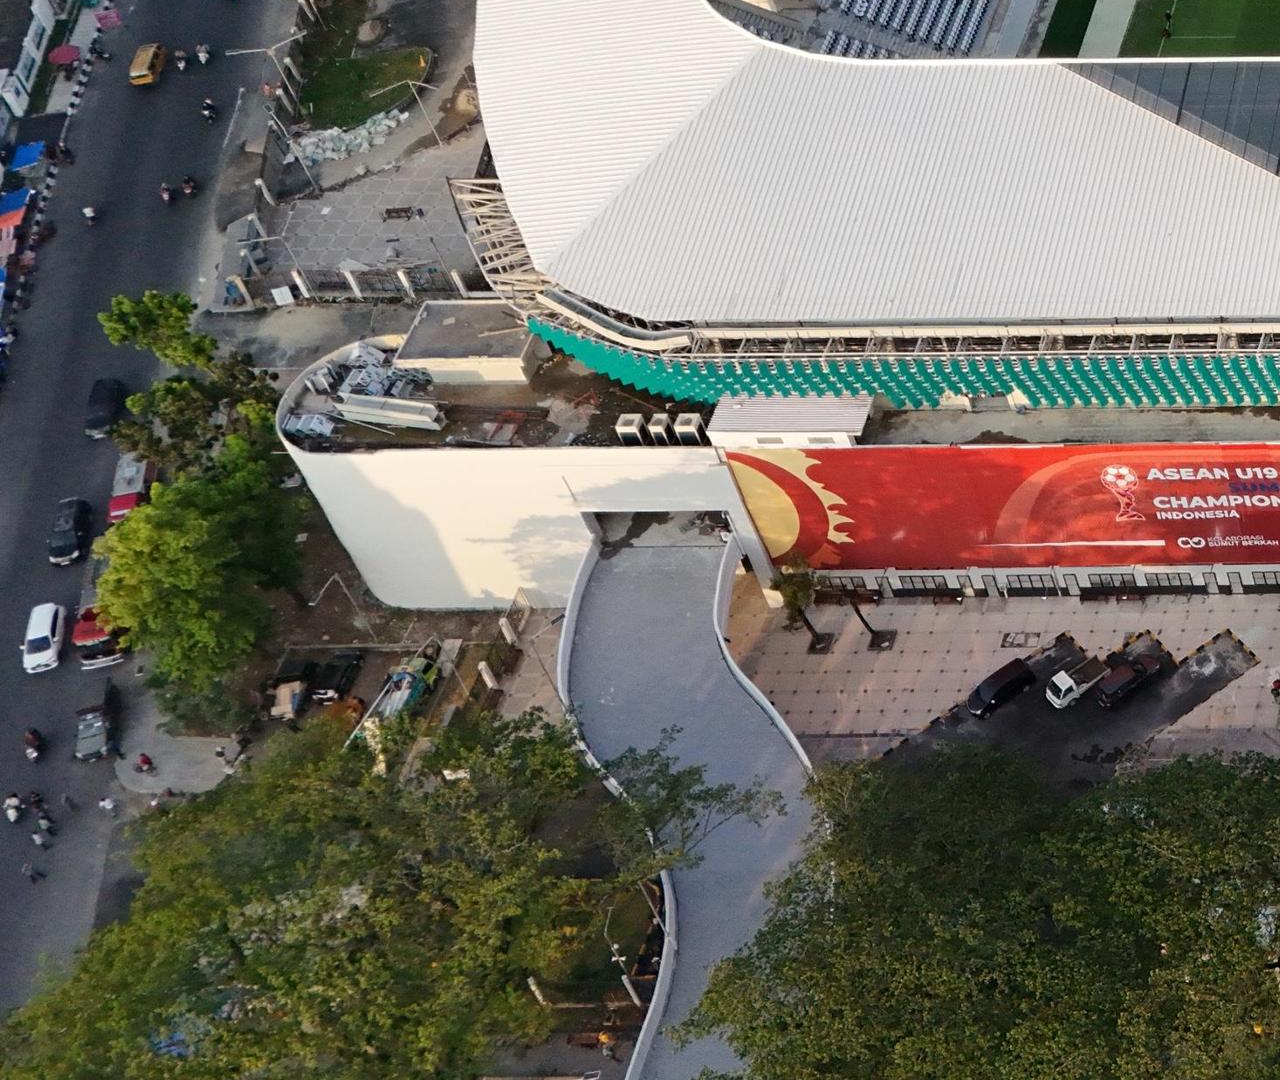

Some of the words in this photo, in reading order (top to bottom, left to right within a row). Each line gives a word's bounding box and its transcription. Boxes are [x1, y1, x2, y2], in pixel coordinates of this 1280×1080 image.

[1146, 467, 1230, 481] ASEAN
[1236, 466, 1277, 480] U19
[1156, 509, 1240, 520] INDONESIA
